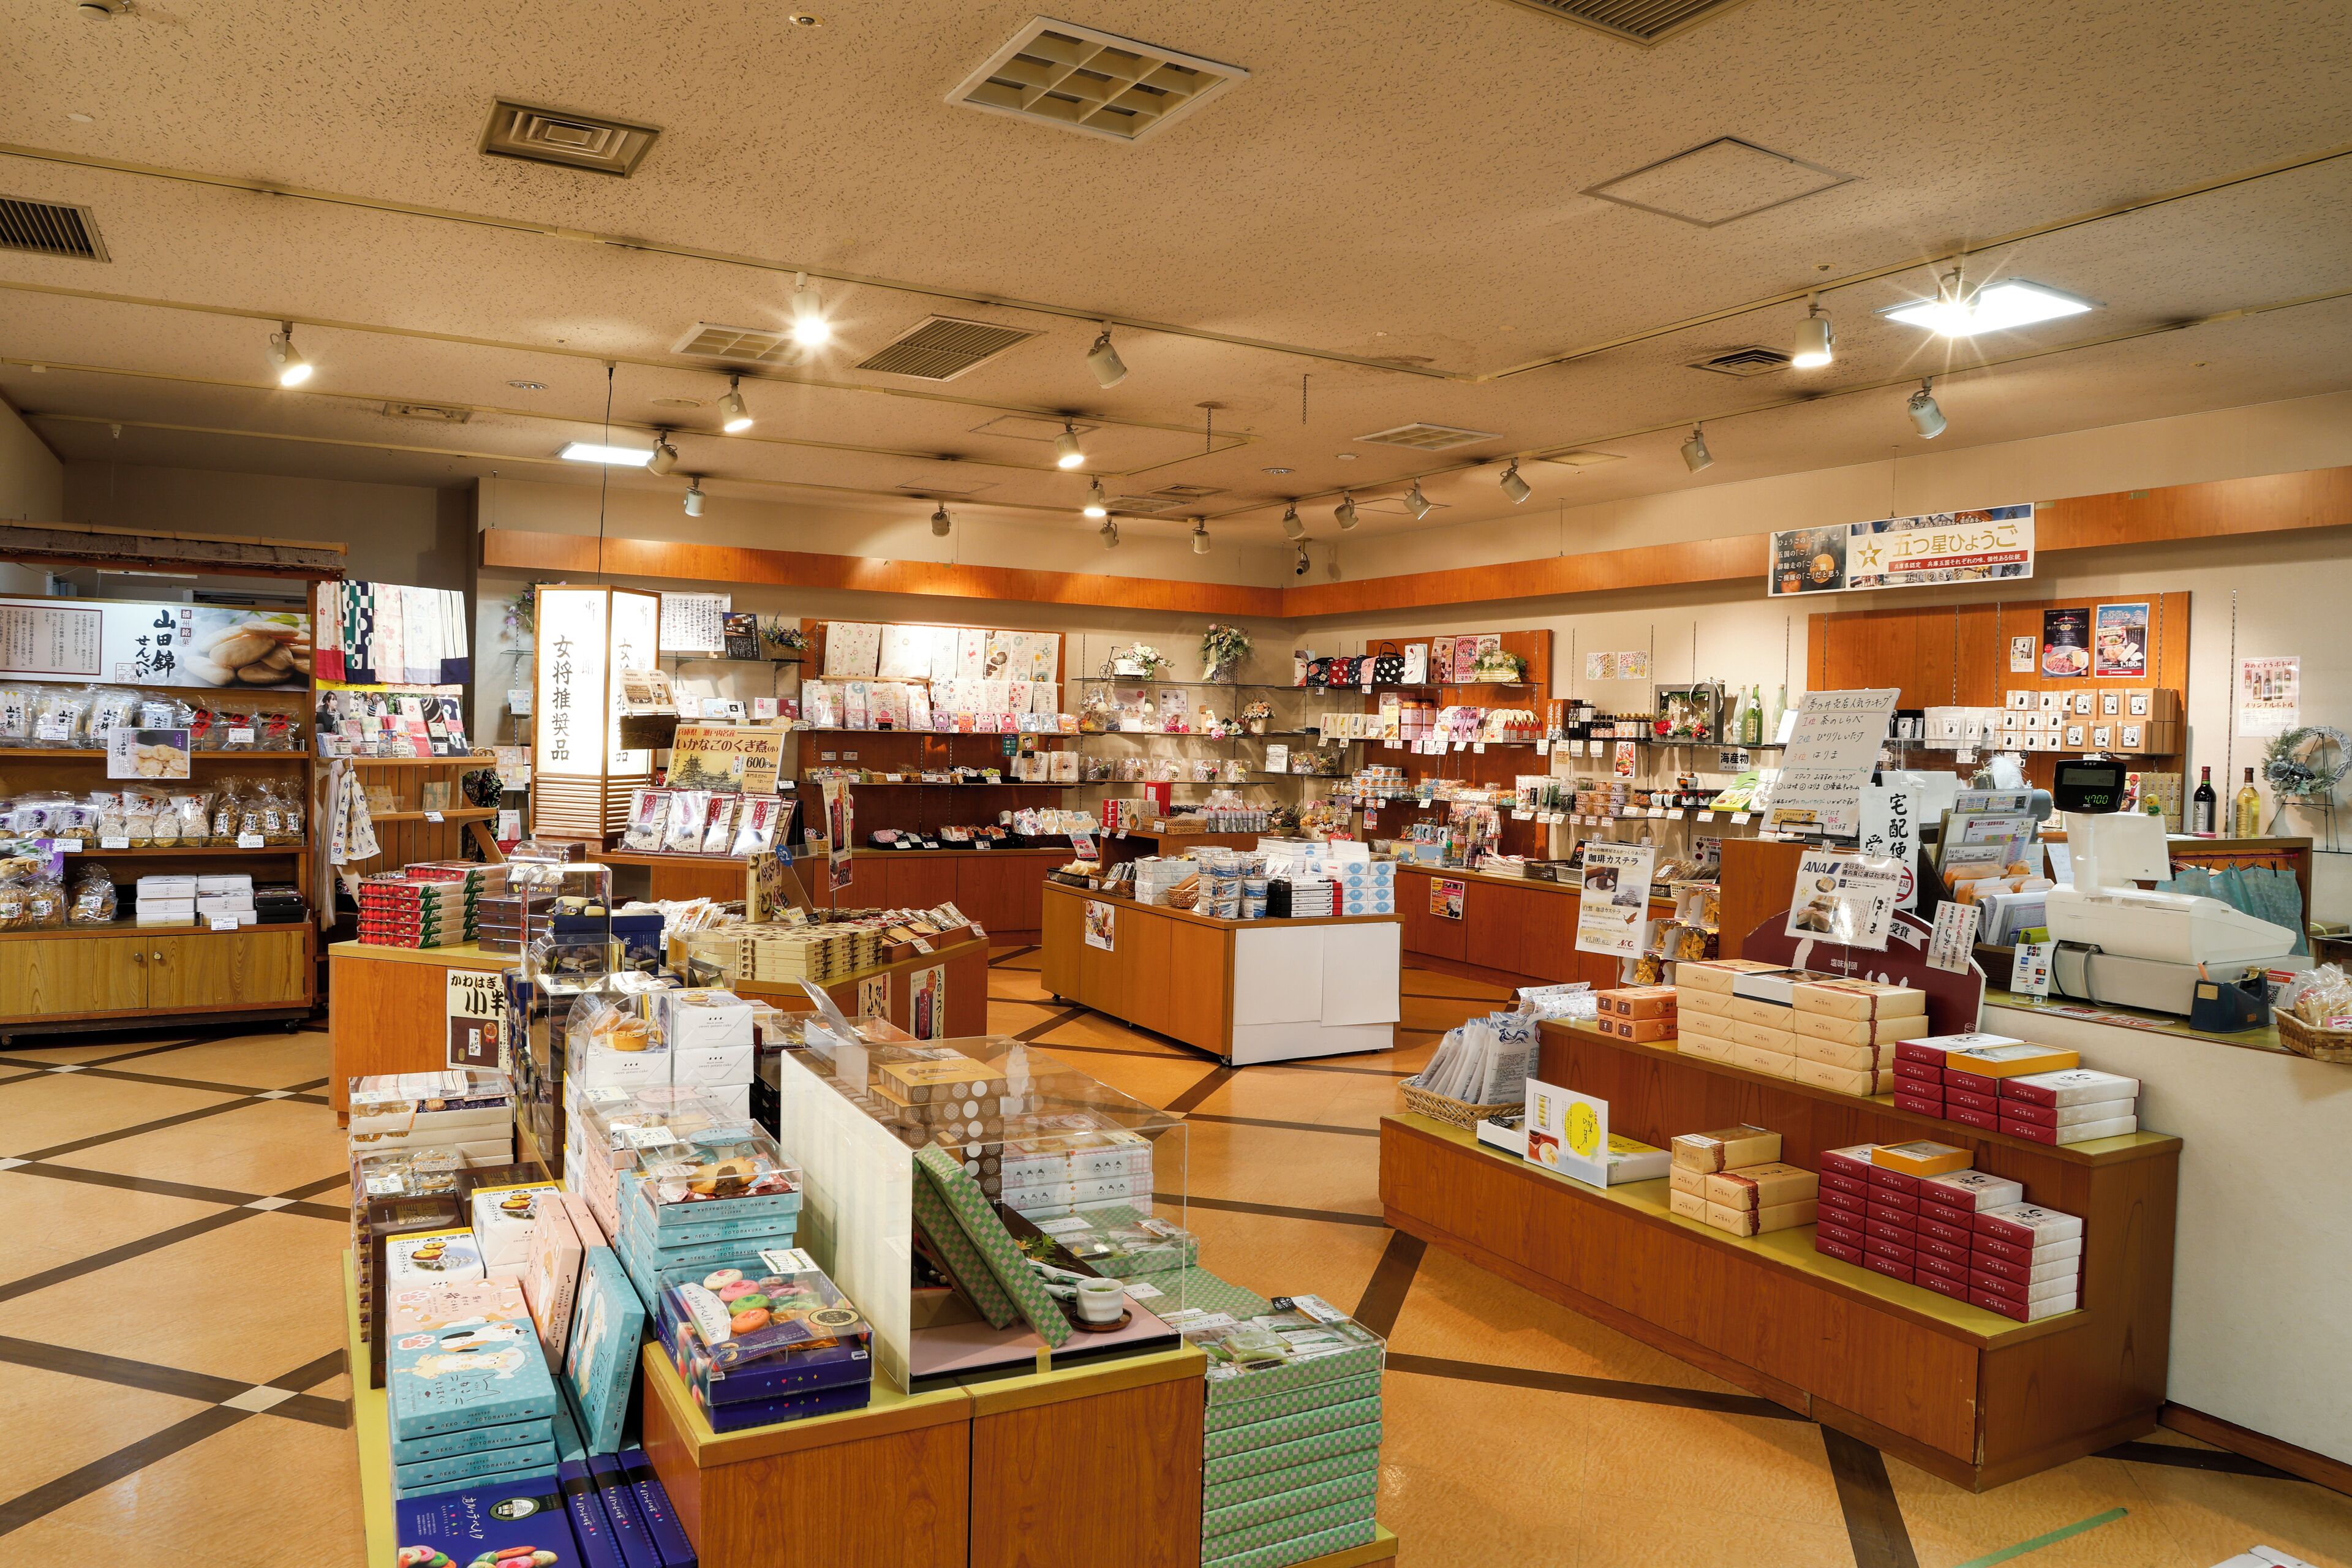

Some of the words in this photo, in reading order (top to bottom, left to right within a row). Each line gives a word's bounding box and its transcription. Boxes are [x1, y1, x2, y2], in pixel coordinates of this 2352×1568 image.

[1892, 523, 2018, 557] 五つ星ひょうご
[1894, 562, 1921, 570] 兵庫県認定
[151, 609, 176, 678] 山田錦
[135, 635, 151, 677] せんべい
[551, 634, 574, 761] 女将推奨品
[59, 710, 67, 726] 山田
[676, 739, 779, 753] いかなごのくぎ煮(小)
[1720, 752, 1749, 765] 海産物
[1812, 750, 1838, 760] はりま
[1588, 853, 1639, 866] 珈琲カステラ
[1802, 861, 1828, 873] ANA
[1842, 870, 1897, 881] 機内食に選ばれました
[1890, 921, 1911, 940] 受賞
[2026, 945, 2041, 957] JCB
[450, 974, 497, 989] かわはぎ
